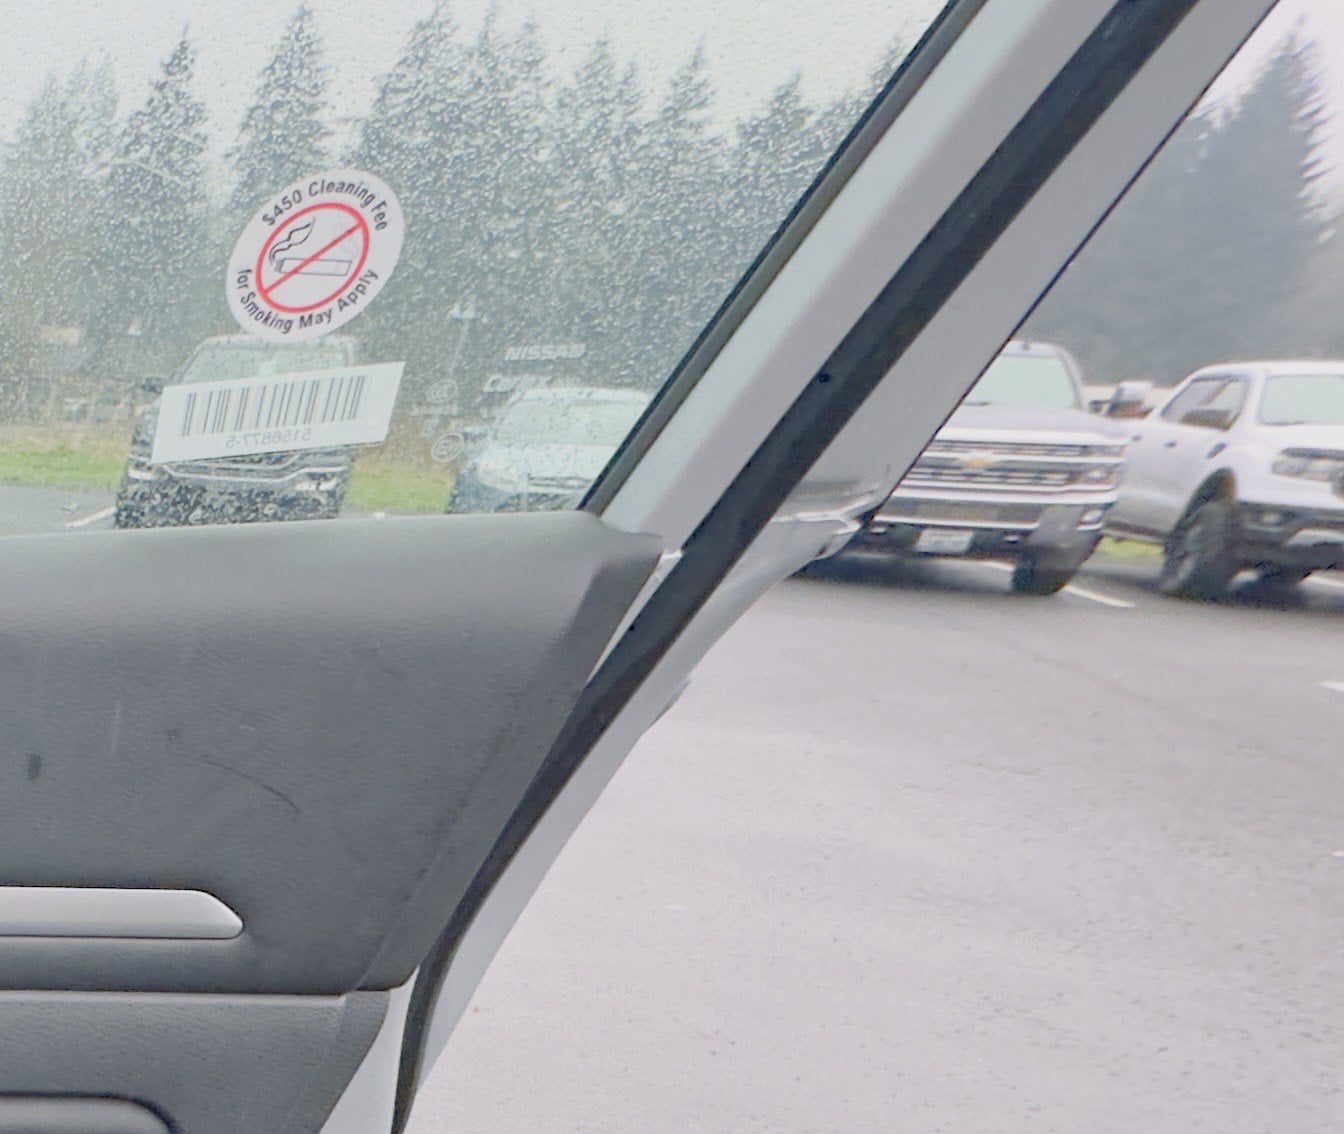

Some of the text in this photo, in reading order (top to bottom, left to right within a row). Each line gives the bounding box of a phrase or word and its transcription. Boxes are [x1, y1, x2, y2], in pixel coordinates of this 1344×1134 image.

[262, 178, 388, 232] $450 Cleaning Fee
[236, 268, 379, 334] for Smoking May Apply
